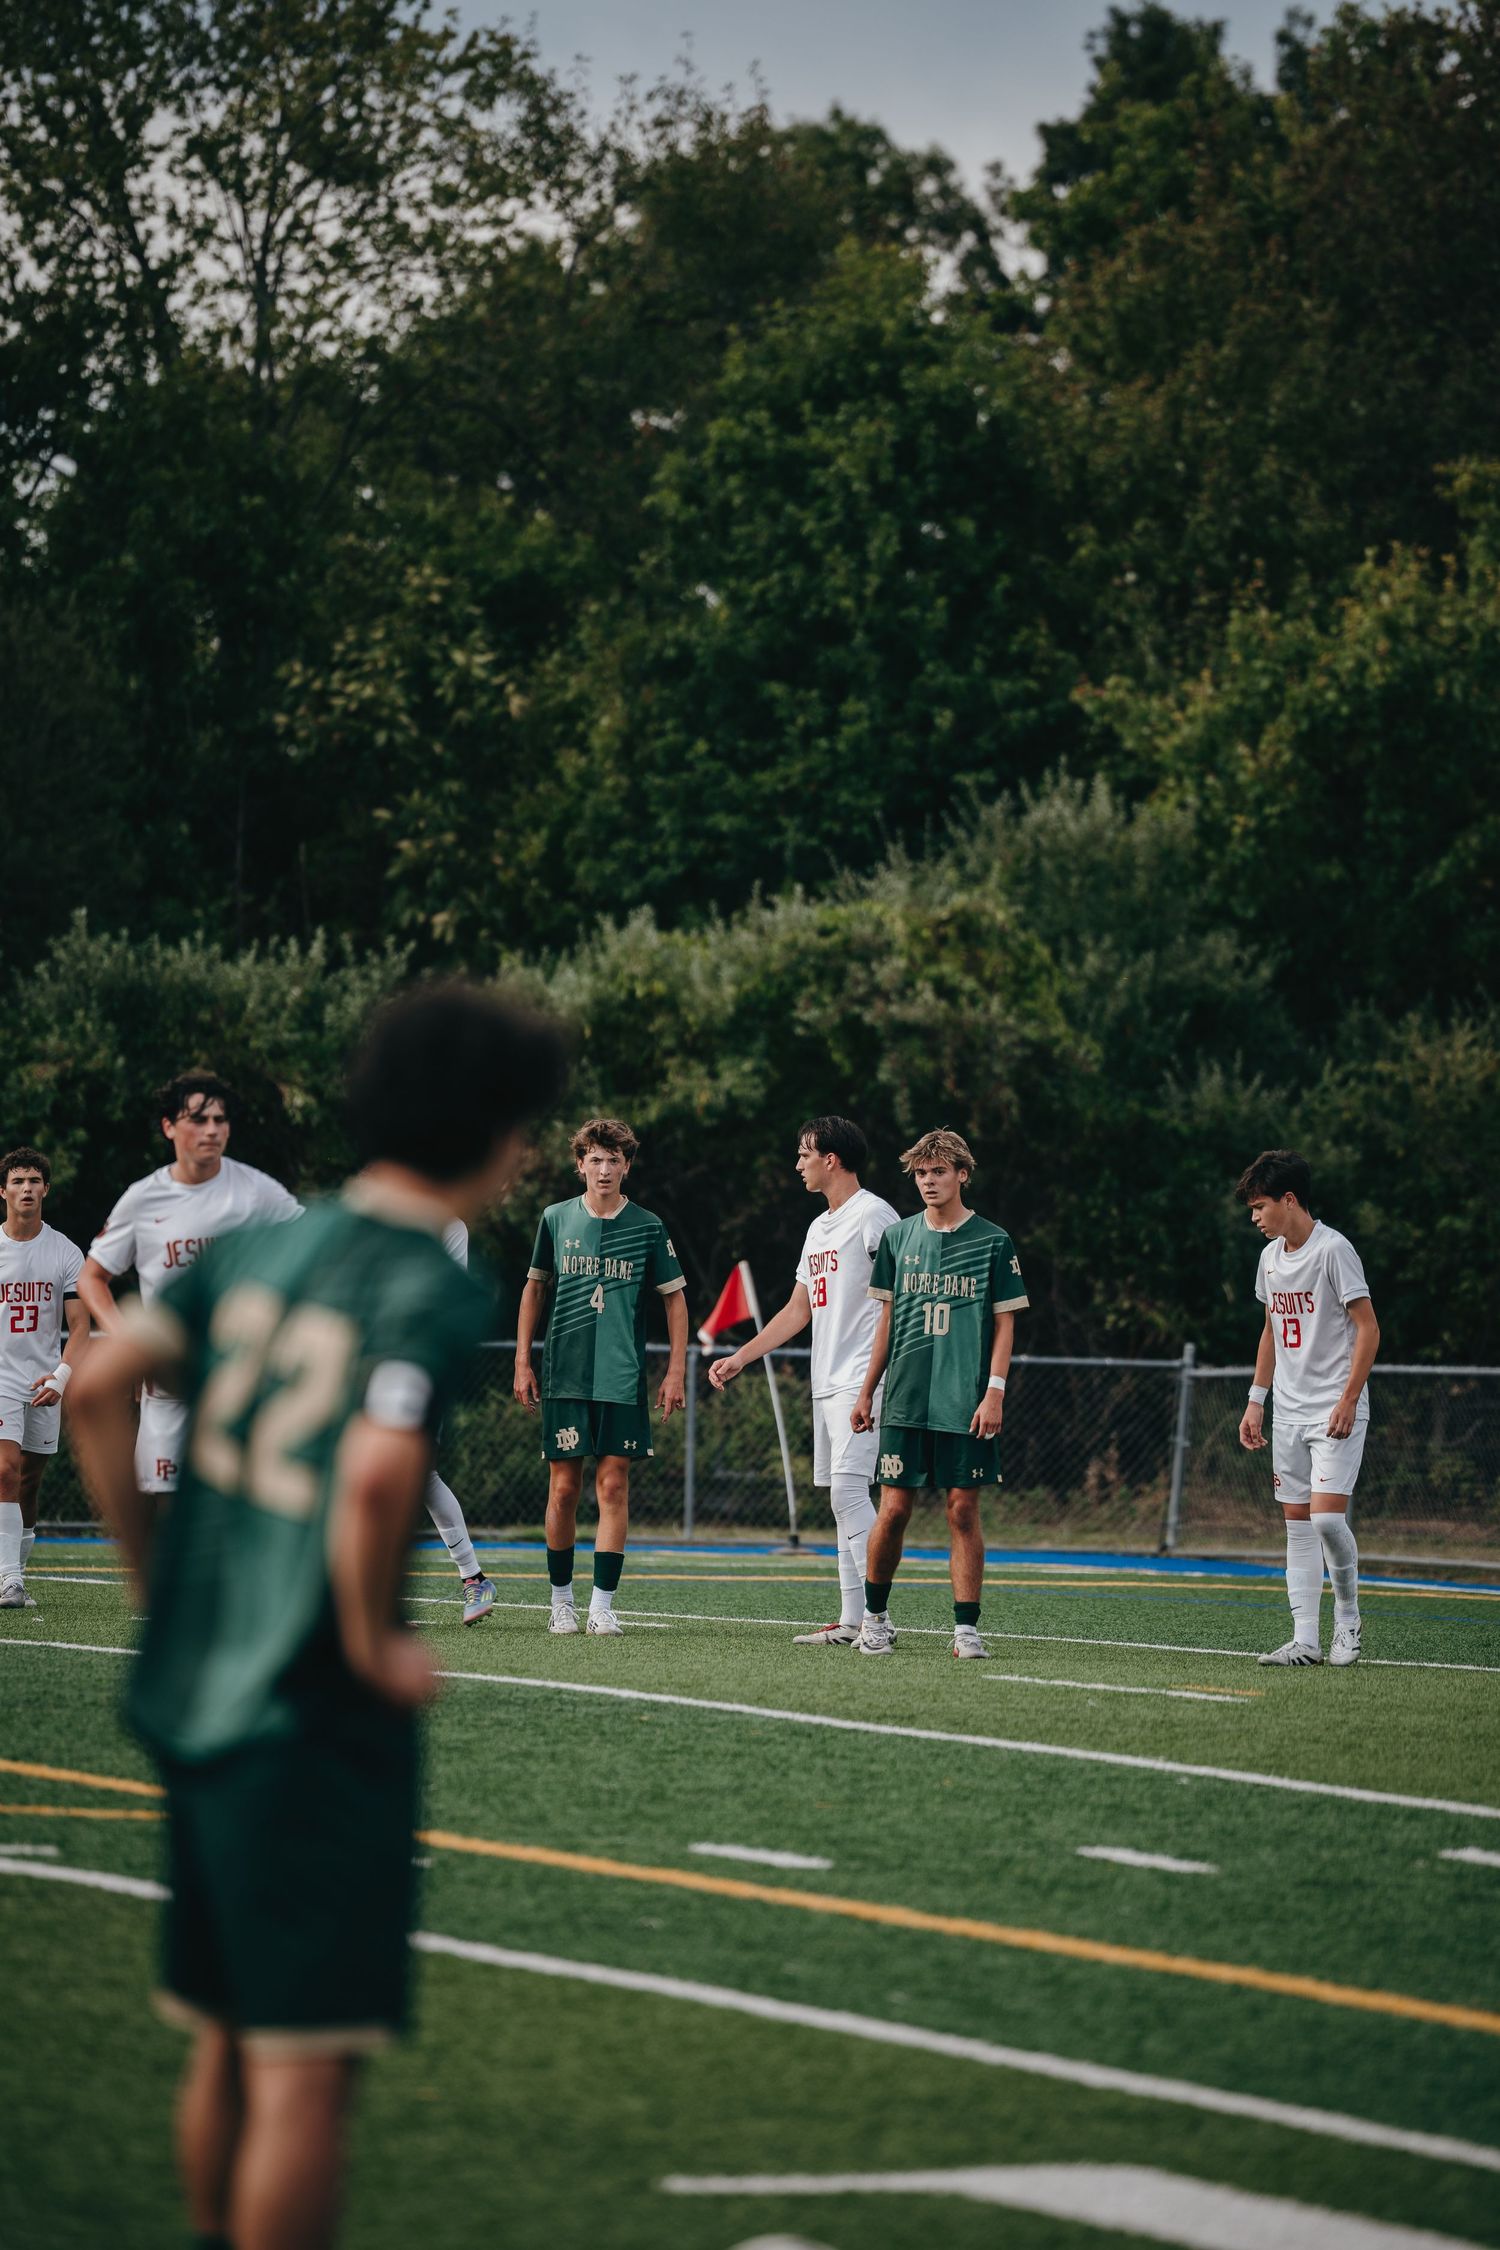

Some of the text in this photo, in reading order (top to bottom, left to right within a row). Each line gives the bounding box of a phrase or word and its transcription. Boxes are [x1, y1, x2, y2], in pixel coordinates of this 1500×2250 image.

[562, 1255, 634, 1280] NOTRE DAME
[0, 1282, 53, 1303] JESUITS
[589, 1284, 605, 1314] 4
[812, 1277, 827, 1309] 28
[902, 1273, 977, 1298] NOTRE DAME
[1270, 1291, 1315, 1315] JESUITS
[10, 1305, 39, 1333] 23
[922, 1302, 951, 1336] 10
[1282, 1318, 1302, 1348] 13
